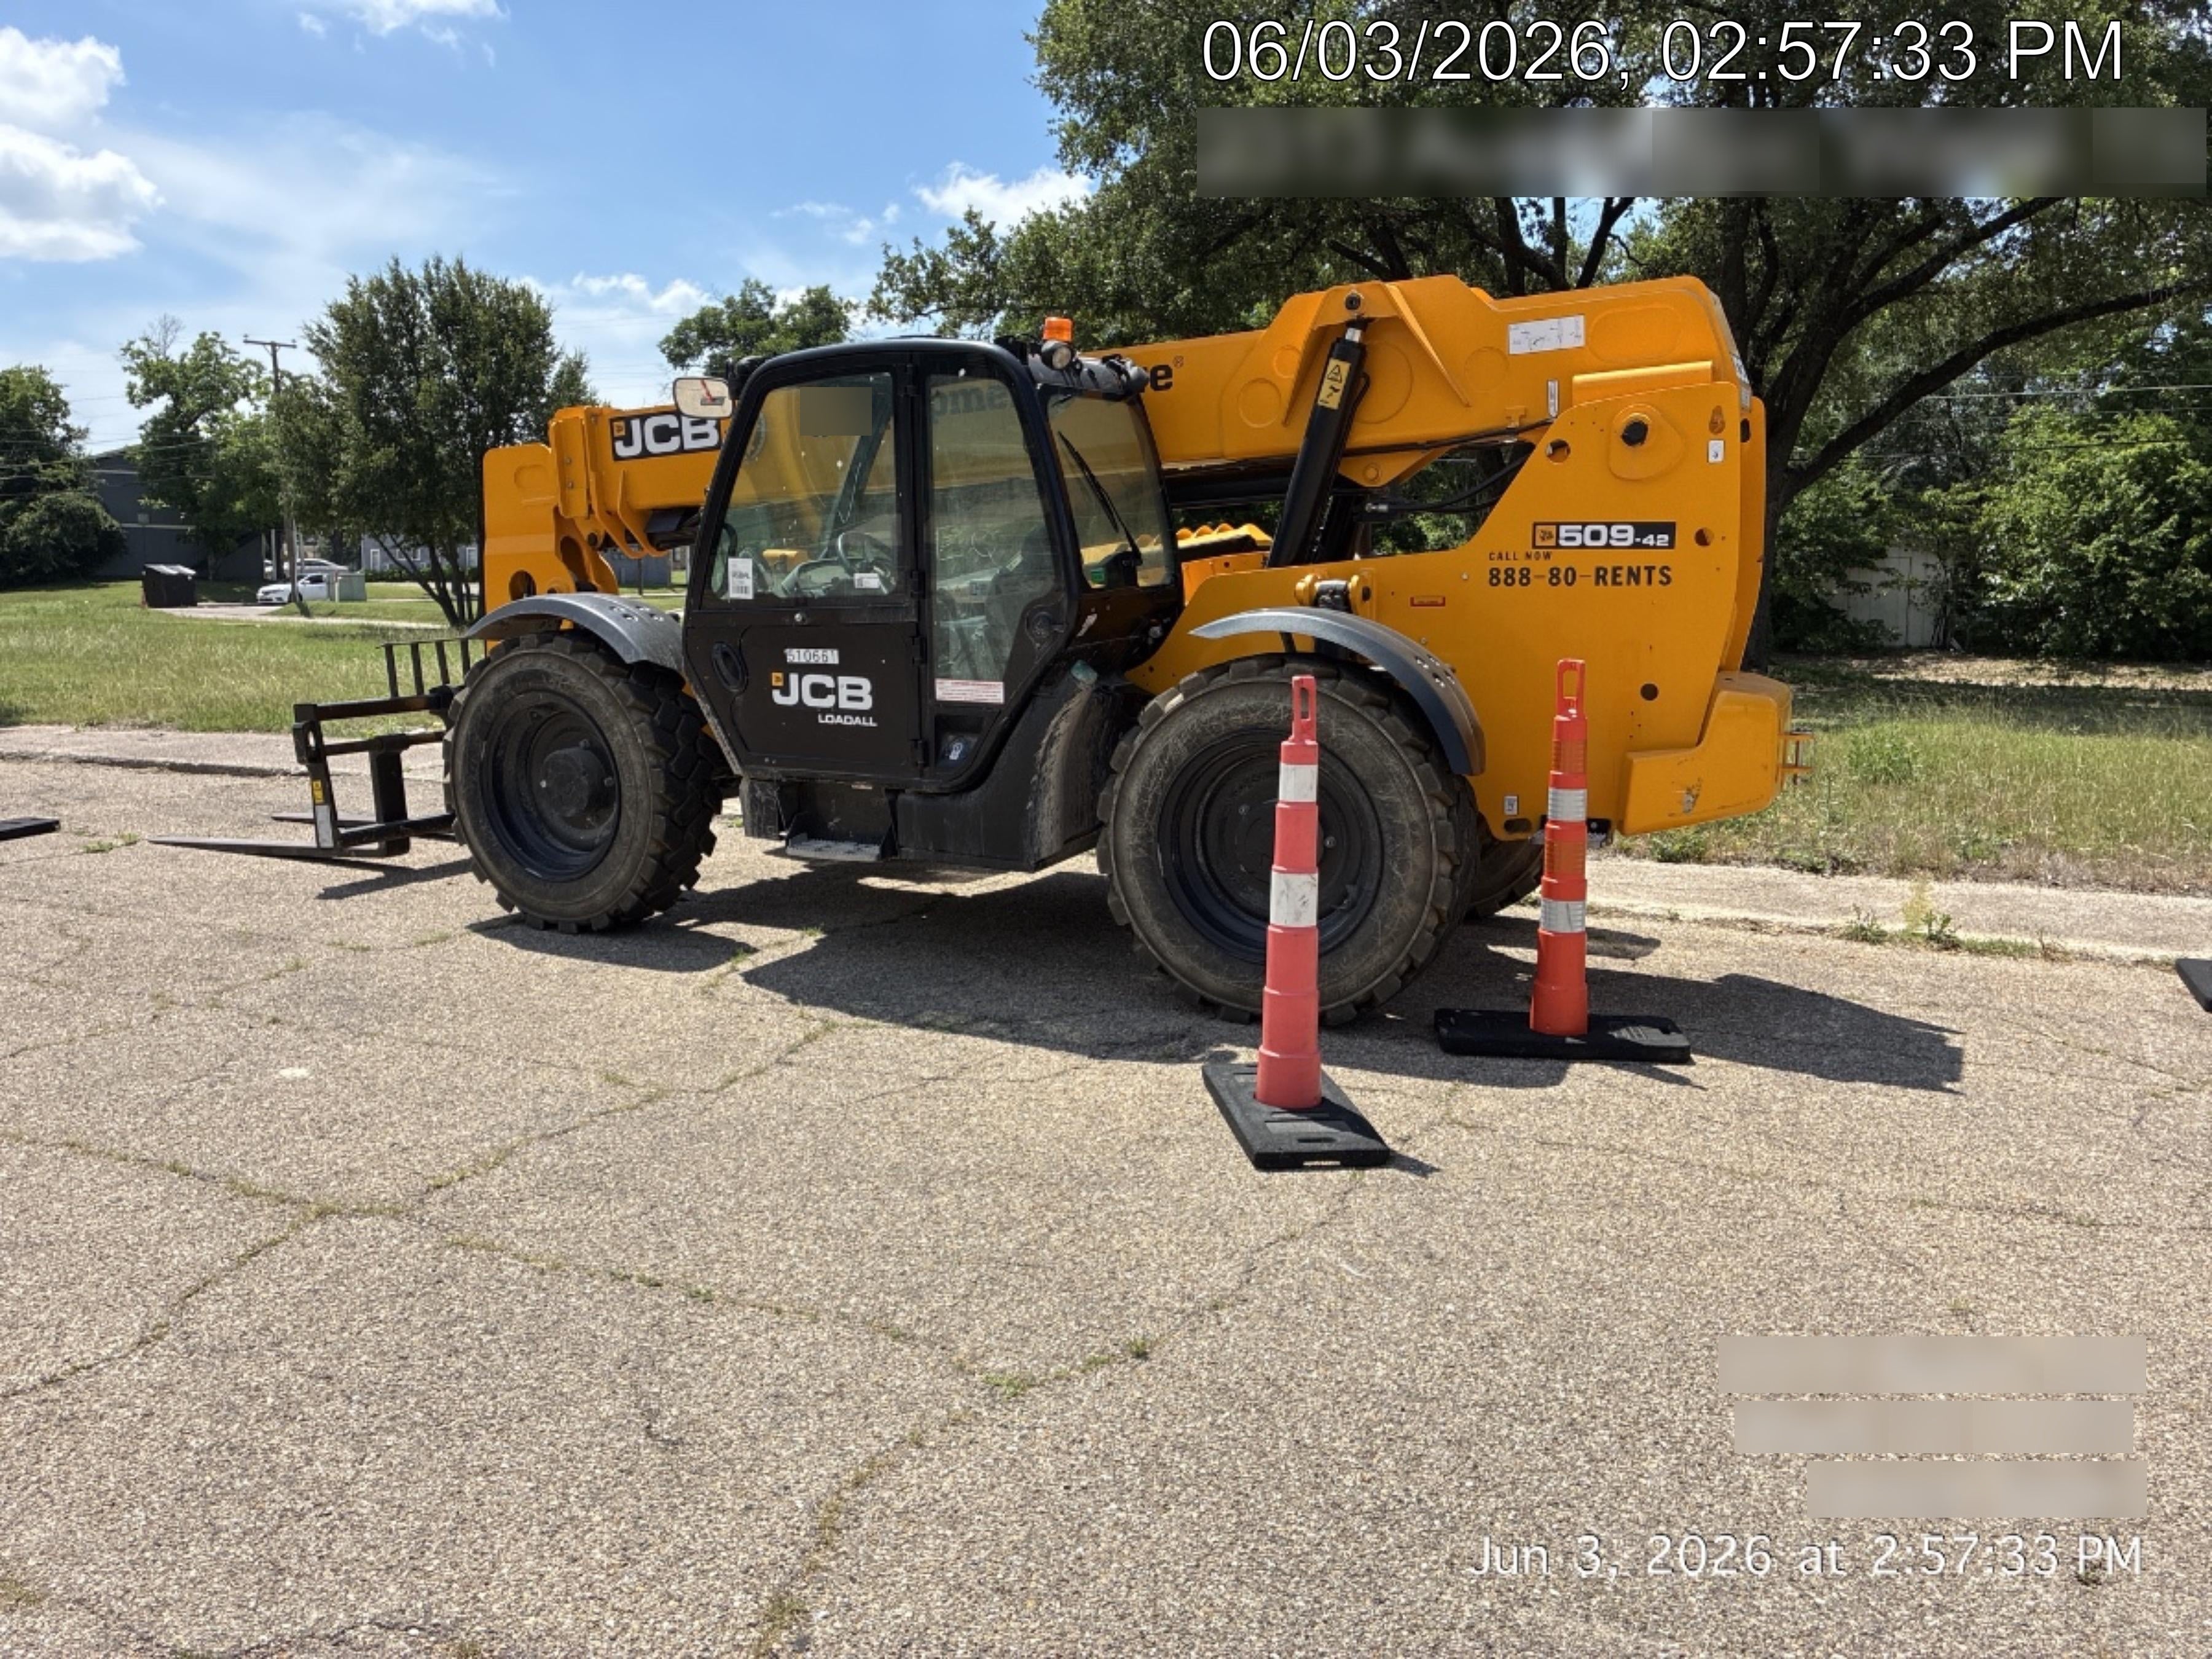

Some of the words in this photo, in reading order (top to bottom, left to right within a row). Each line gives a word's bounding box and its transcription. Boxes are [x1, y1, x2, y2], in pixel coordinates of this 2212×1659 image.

[614, 414, 720, 457] JCB
[1558, 525, 1669, 546] 509-42
[1489, 551, 1518, 560] CALL
[1525, 551, 1552, 560] NOW
[1489, 565, 1672, 586] 888-80-RENTS
[772, 672, 873, 710] JCB
[818, 713, 877, 727] LOADALL
